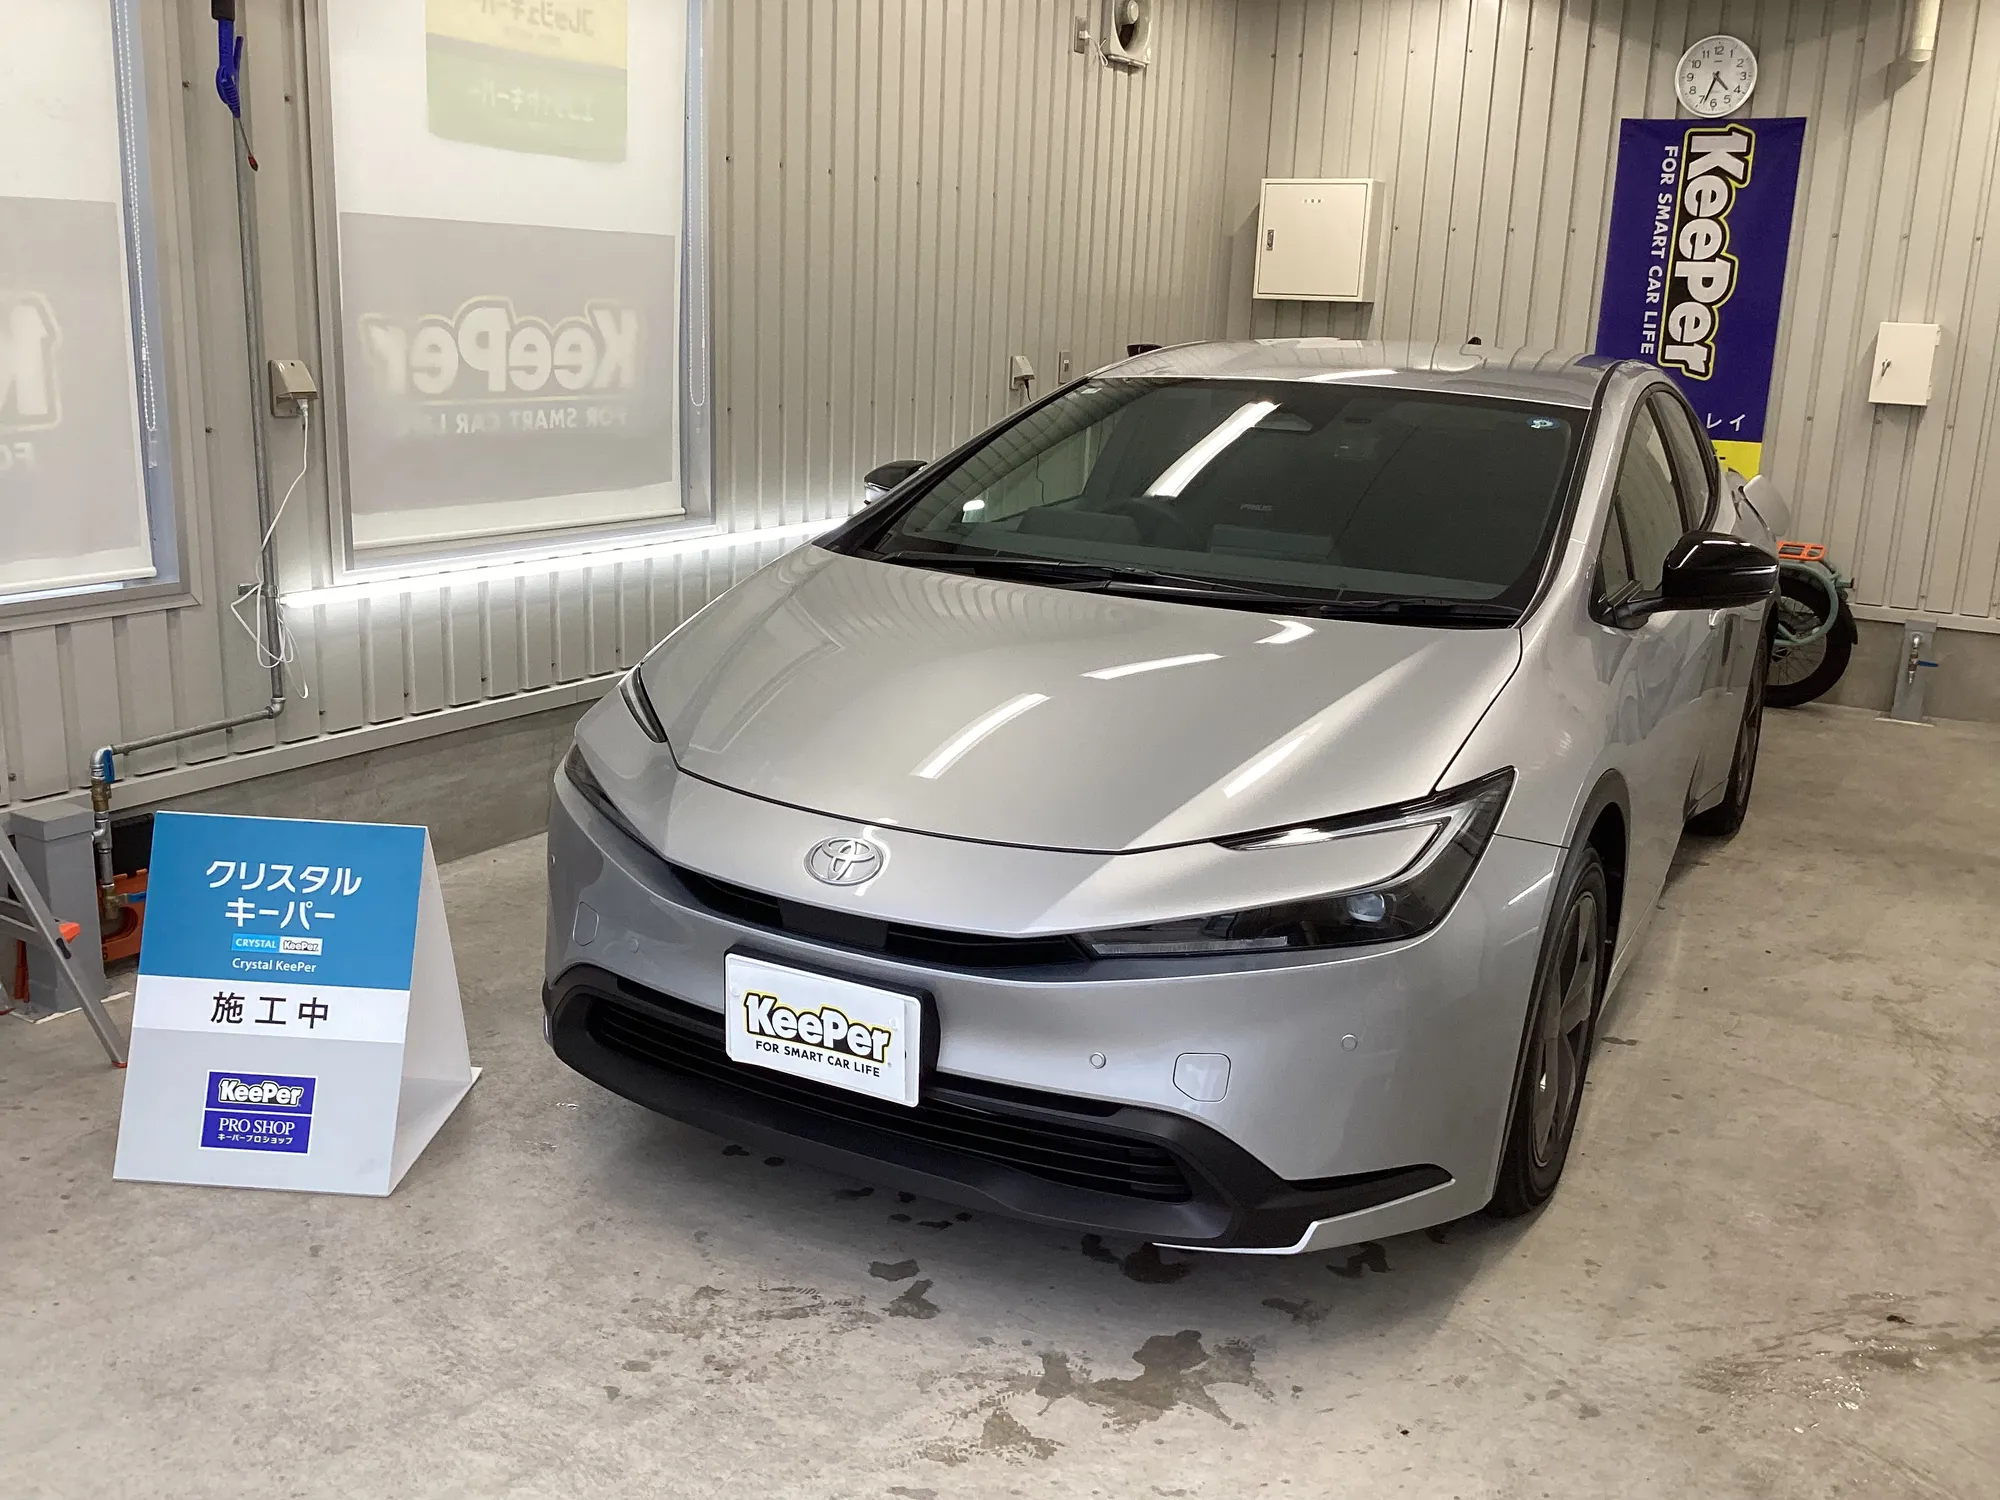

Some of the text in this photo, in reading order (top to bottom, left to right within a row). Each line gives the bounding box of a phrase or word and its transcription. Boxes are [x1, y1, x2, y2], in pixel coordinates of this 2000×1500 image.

[1702, 50, 1710, 58] 11
[1714, 45, 1724, 55] 12
[1691, 60, 1701, 69] 10
[1736, 59, 1744, 67] 2
[1686, 73, 1694, 81] 9
[1740, 72, 1747, 80] 3
[1689, 86, 1696, 95] 8
[1734, 85, 1741, 93] 4
[1710, 99, 1717, 107] 6
[1724, 95, 1731, 104] 5
[1640, 145, 1679, 354] FOR SMART CAR LIFE
[1661, 127, 1753, 378] KeePer
[206, 860, 363, 896] クリスタル
[225, 897, 336, 931] キーパー
[235, 938, 319, 951] CRYSTAL KeePer
[232, 958, 317, 973] Crystal KeePer
[211, 991, 329, 1029] 施工中
[743, 991, 892, 1064] KeePer
[755, 1040, 880, 1077] FOR SMART CAR LIFE
[219, 1079, 303, 1106] KeePer
[219, 1117, 295, 1135] PRO SHOP
[217, 1133, 293, 1145] キーパープロショップ
